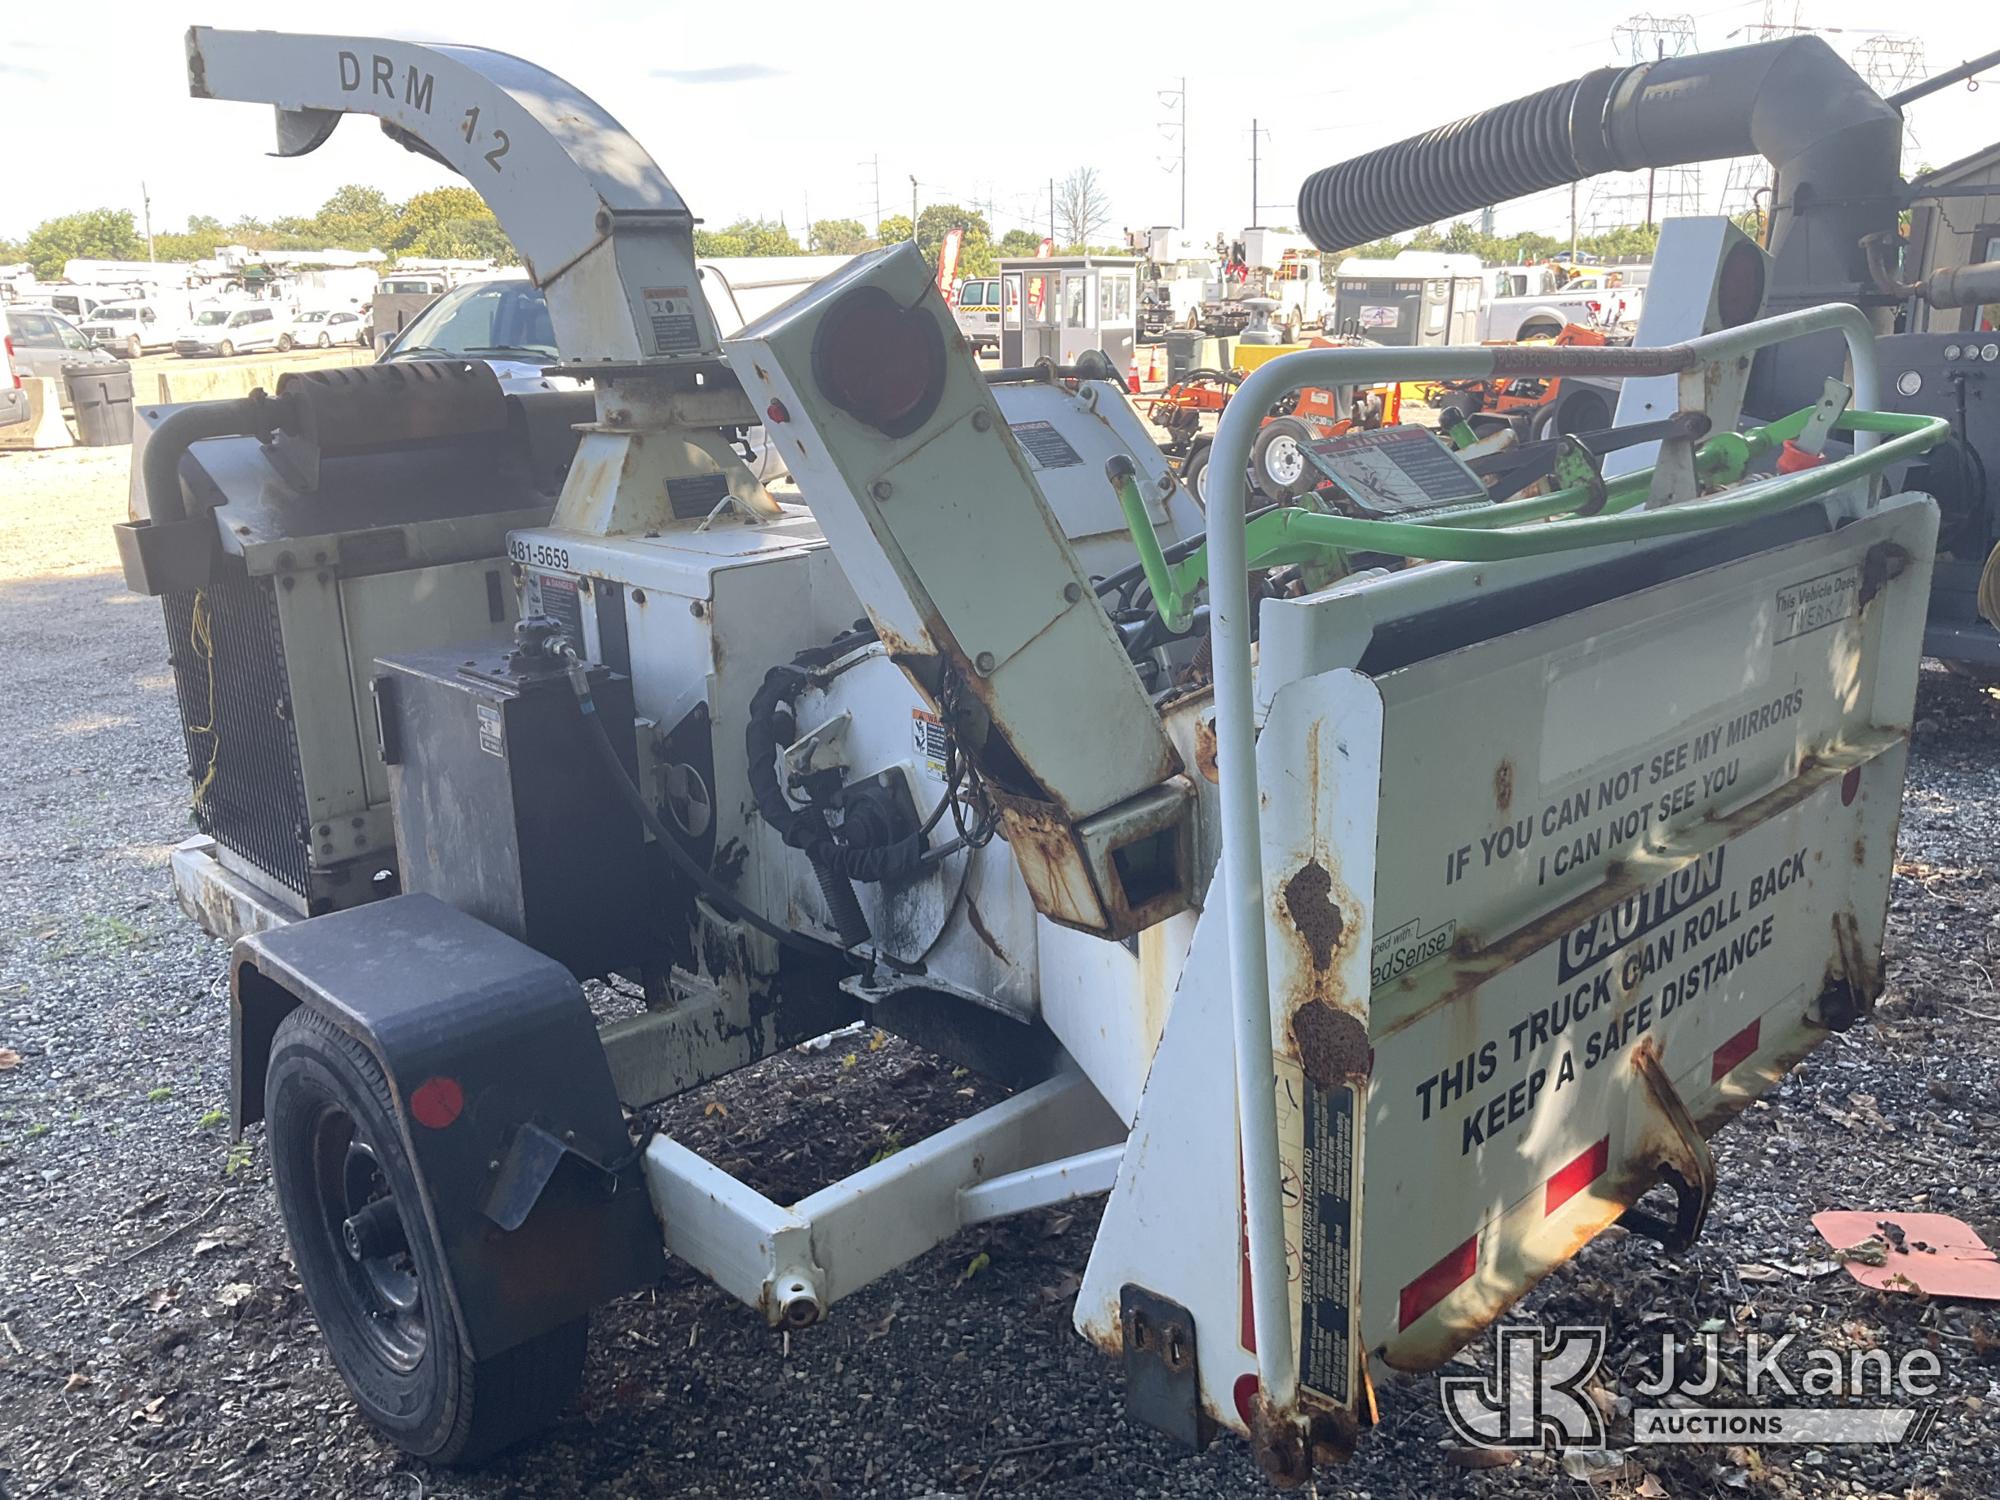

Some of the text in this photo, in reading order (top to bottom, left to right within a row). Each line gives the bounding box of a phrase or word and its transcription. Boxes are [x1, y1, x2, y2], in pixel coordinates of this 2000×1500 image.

[339, 51, 510, 173] DRM 12
[511, 541, 569, 570] 481-5659
[1447, 689, 1803, 885] IF YOU CAN NOT SEE MY MIRRORS
[1538, 759, 1740, 885] I CAN NOT SEE YOU
[1564, 848, 1724, 971] CAUTION
[1416, 848, 1808, 1121] THIS TRUCK CAN ROLL BACK
[1462, 915, 1775, 1156] KEEP A SAFE DISTANCE
[1303, 1148, 1312, 1303] SEVER & CRUSH HAZARD
